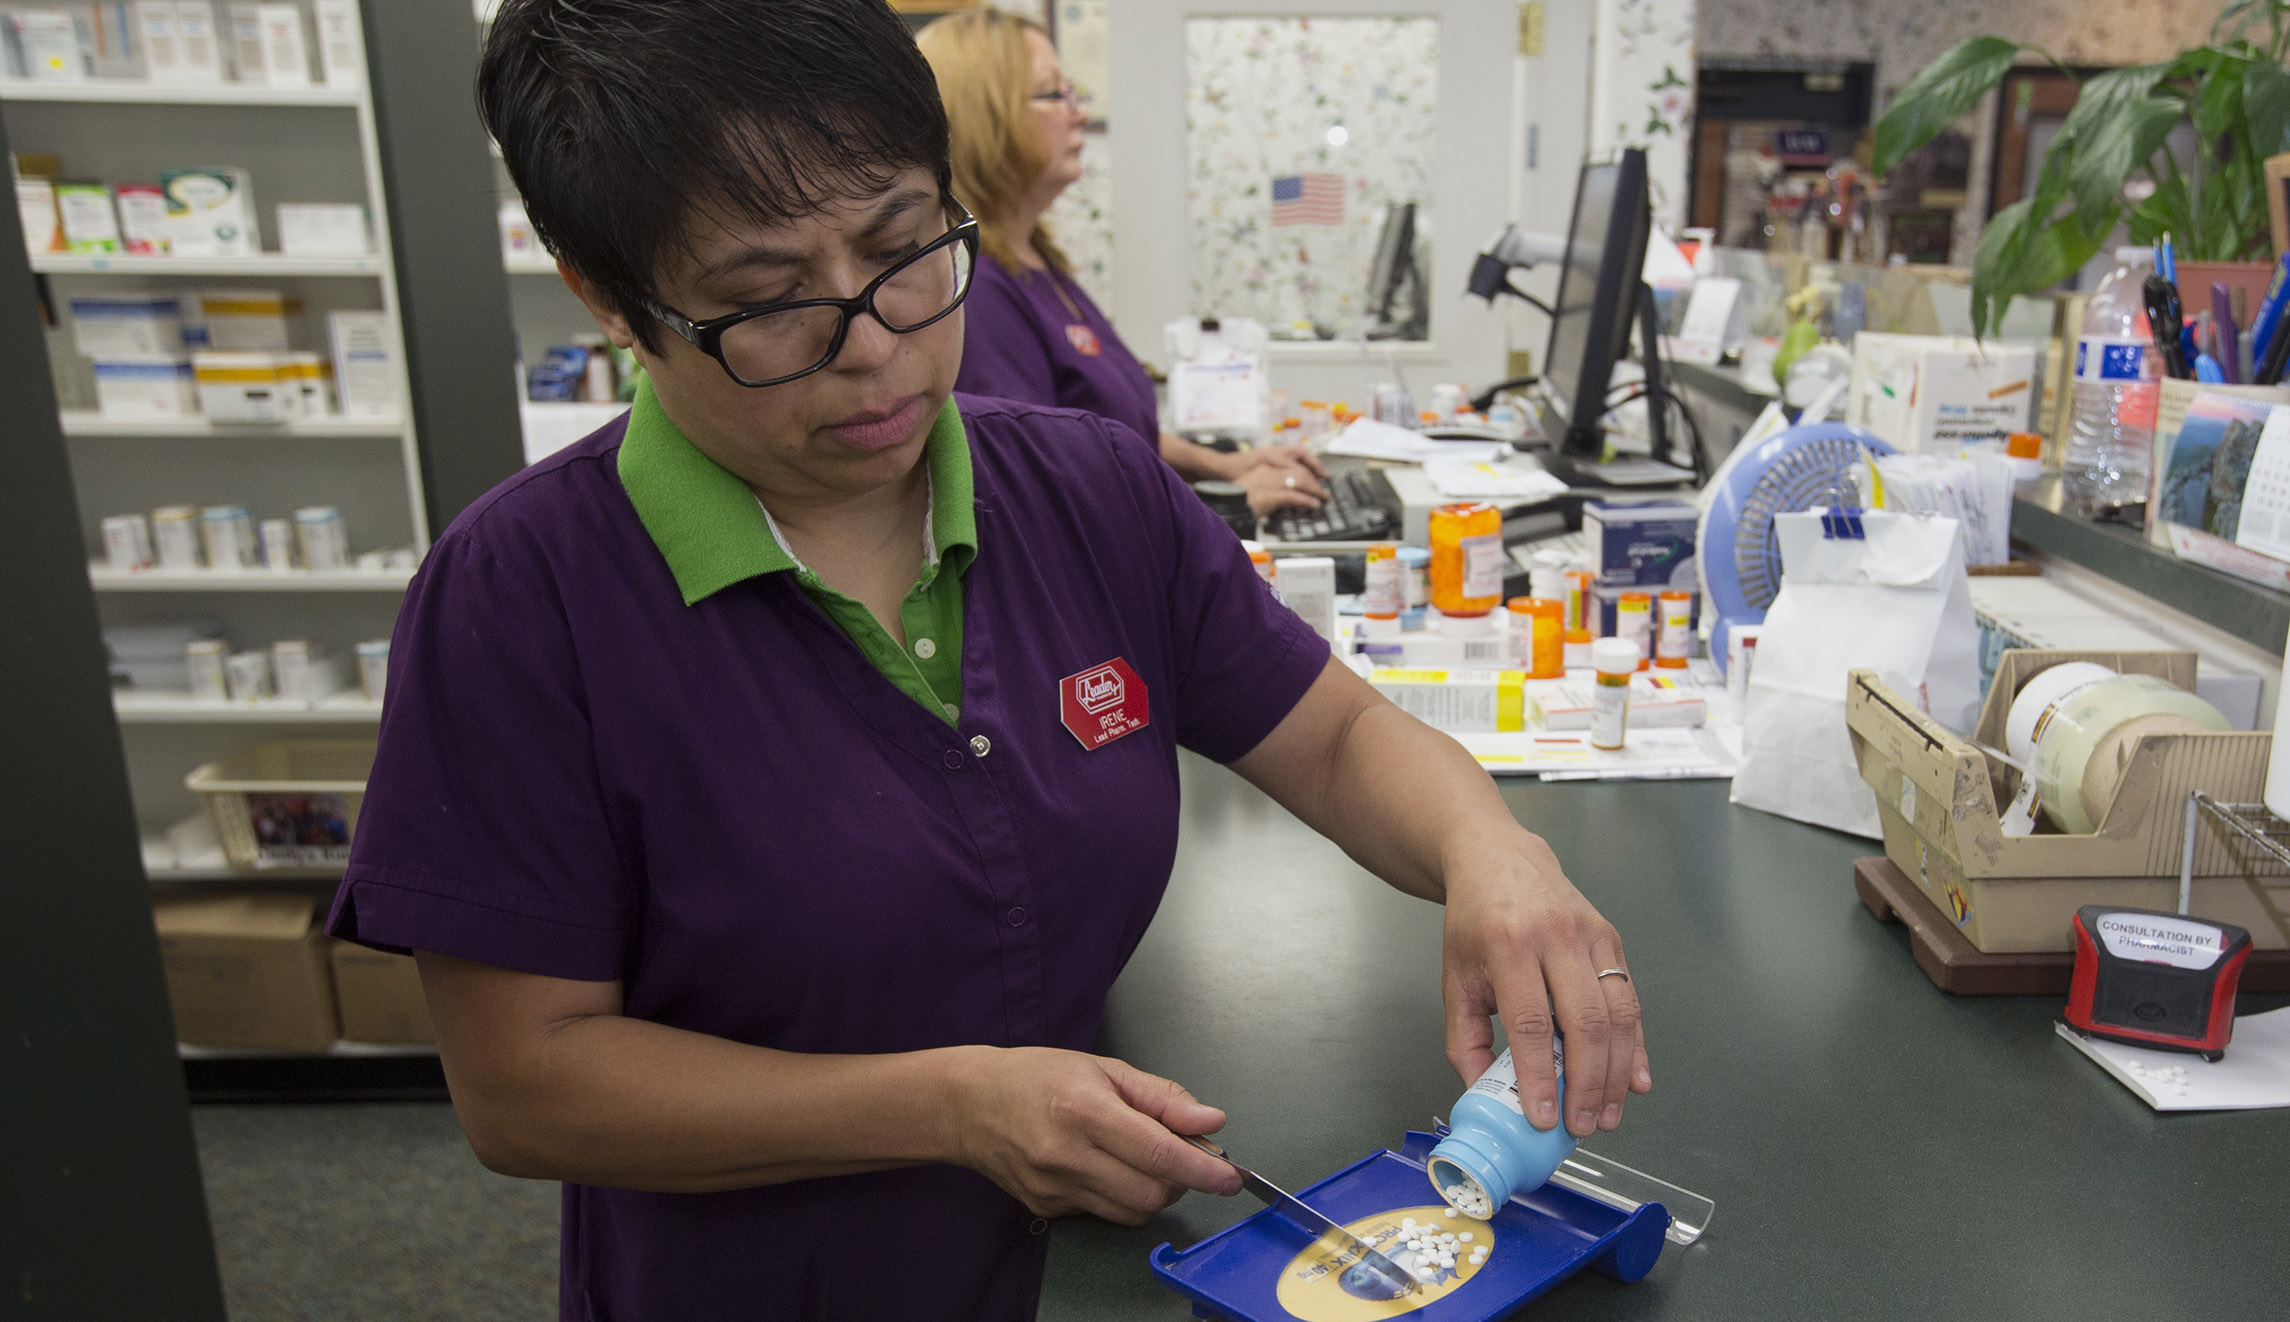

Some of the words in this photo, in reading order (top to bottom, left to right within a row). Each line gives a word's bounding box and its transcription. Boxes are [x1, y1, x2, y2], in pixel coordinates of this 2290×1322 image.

[1099, 708, 1127, 729] IRENE
[1094, 731, 1108, 743] Lead
[2102, 920, 2192, 943] CONSULTATION
[2195, 936, 2212, 946] BY
